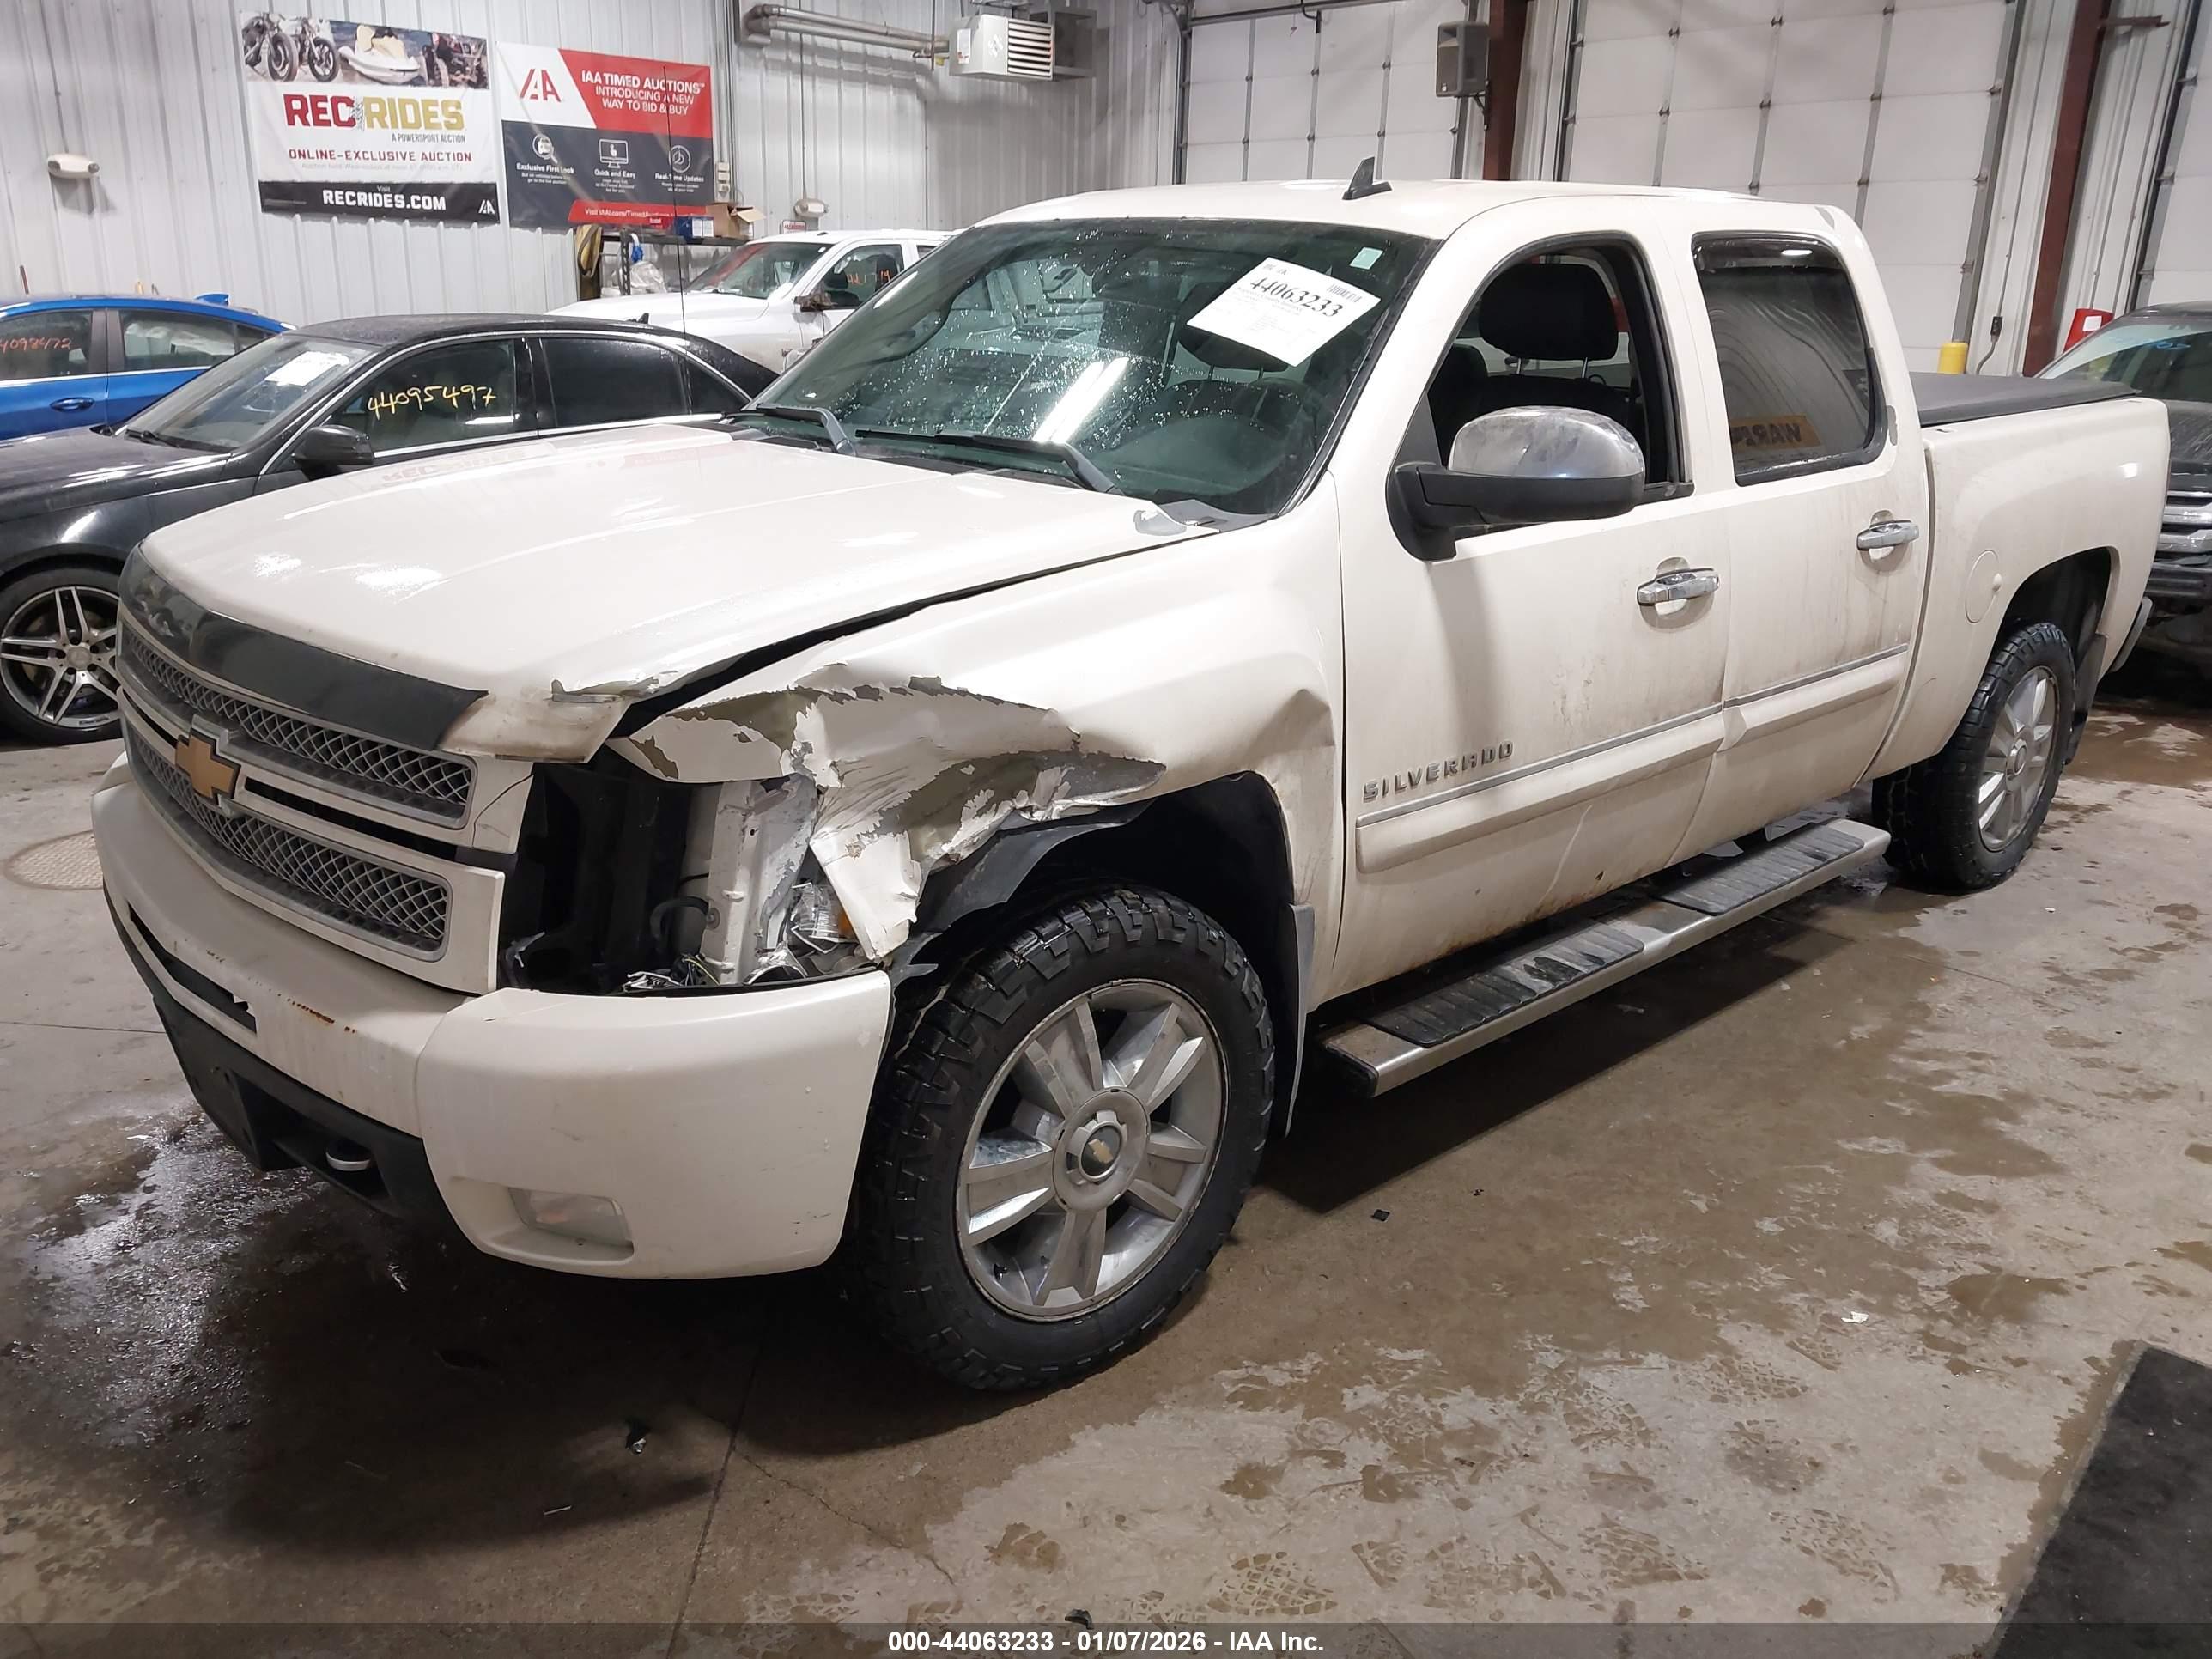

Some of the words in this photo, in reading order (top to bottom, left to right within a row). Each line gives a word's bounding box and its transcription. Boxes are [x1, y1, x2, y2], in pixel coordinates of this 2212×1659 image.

[581, 70, 602, 84] IAA
[603, 73, 641, 88] TIMED
[596, 85, 661, 102] INTRODUCING
[672, 94, 695, 105] NEW
[602, 98, 625, 110] WAY
[626, 100, 641, 111] TO
[642, 101, 658, 112] BID
[659, 104, 667, 114] &
[669, 105, 689, 116] BUY
[392, 132, 397, 143] A
[398, 133, 439, 143] POWERSPORT
[441, 134, 466, 143] AUCTION
[289, 149, 416, 162] ONLINE-EXCLUSIVE
[421, 151, 472, 162] AUCTION
[516, 162, 545, 173] Exclusive
[594, 168, 610, 177] Quick
[623, 170, 636, 179] Easy
[683, 174, 704, 183] Updates
[322, 189, 447, 211] RECRIDES.COM
[585, 207, 598, 216] Visit
[1250, 277, 1344, 317] 44063233
[368, 385, 496, 421] 44095497
[1363, 740, 1514, 804] SILVERADO
